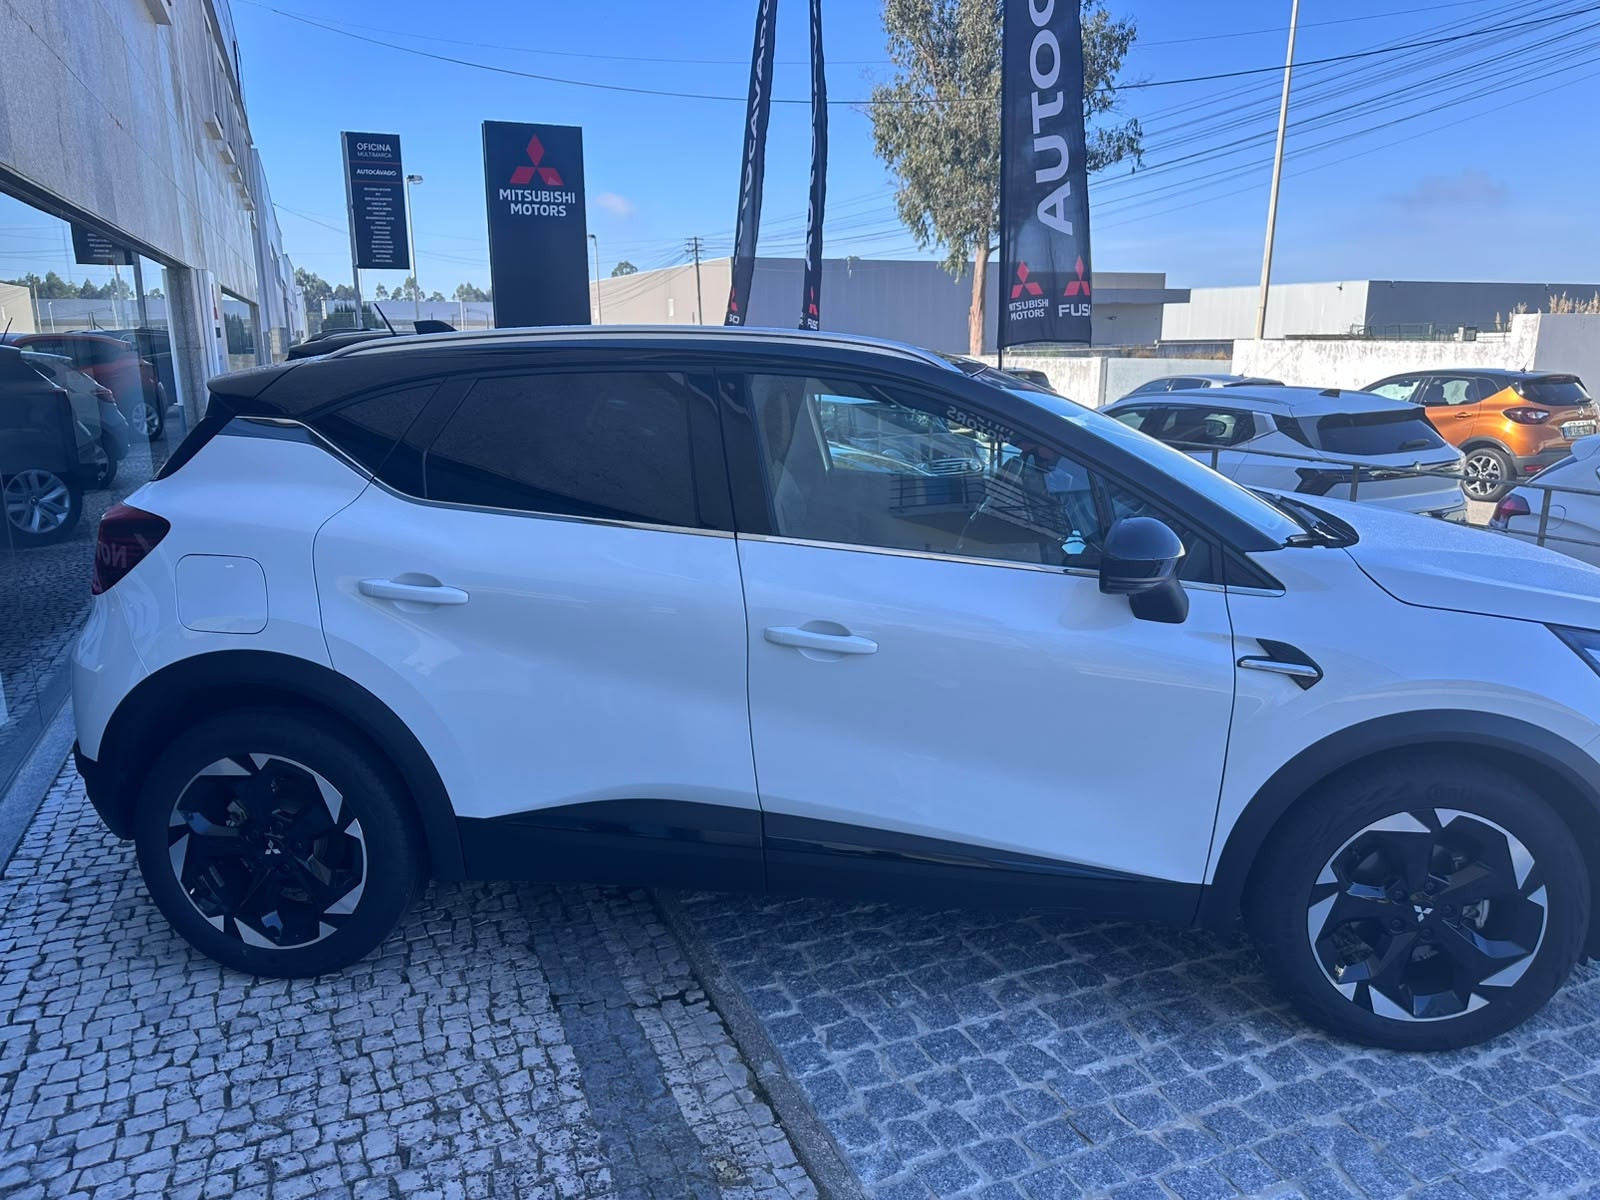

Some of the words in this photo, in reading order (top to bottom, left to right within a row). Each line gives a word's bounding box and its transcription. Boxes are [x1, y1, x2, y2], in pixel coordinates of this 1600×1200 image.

[356, 142, 392, 152] OFICINA
[499, 188, 576, 204] MITSUBISHI
[510, 203, 567, 217] MOTORS
[1058, 303, 1091, 317] FUS
